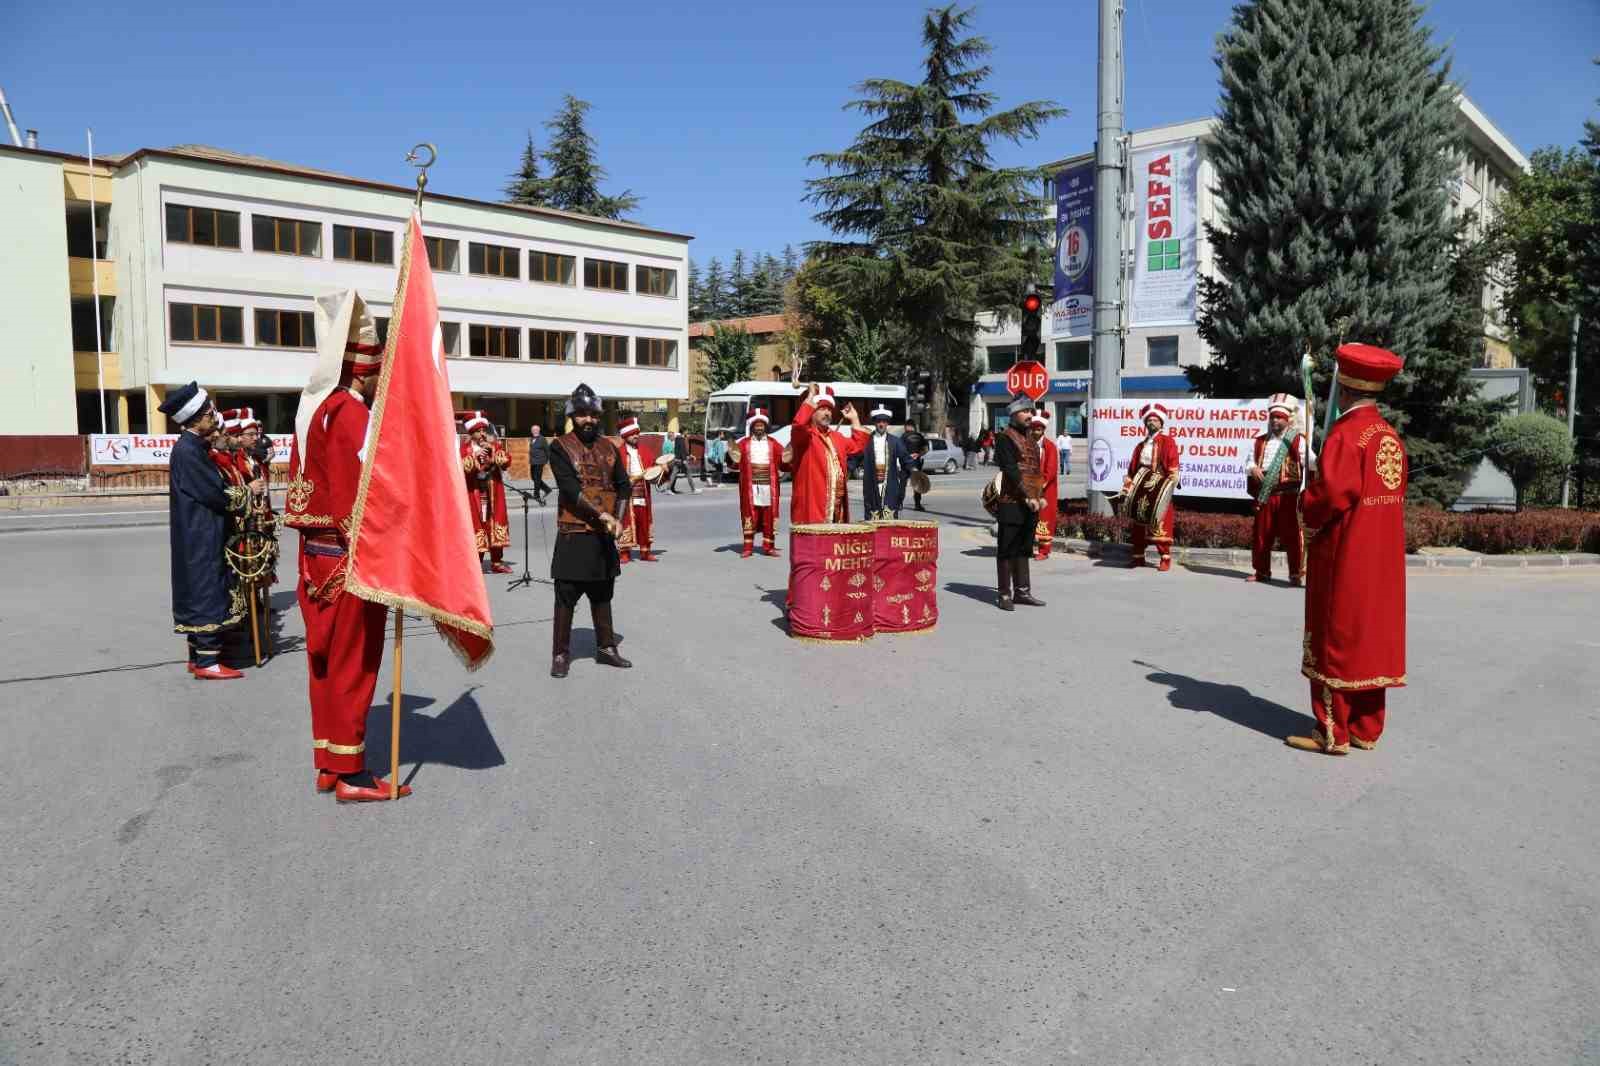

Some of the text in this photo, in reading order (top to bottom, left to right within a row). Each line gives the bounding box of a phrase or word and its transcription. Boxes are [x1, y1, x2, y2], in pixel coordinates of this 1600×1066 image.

[1148, 154, 1173, 240] SEFA
[1066, 231, 1081, 257] 16
[1011, 373, 1045, 389] DUR
[1210, 409, 1268, 421] HAFTAS
[1168, 426, 1261, 440] BAYRAMIMIZ
[1188, 445, 1239, 457] OLSUN
[1185, 462, 1247, 474] SANATKARLA
